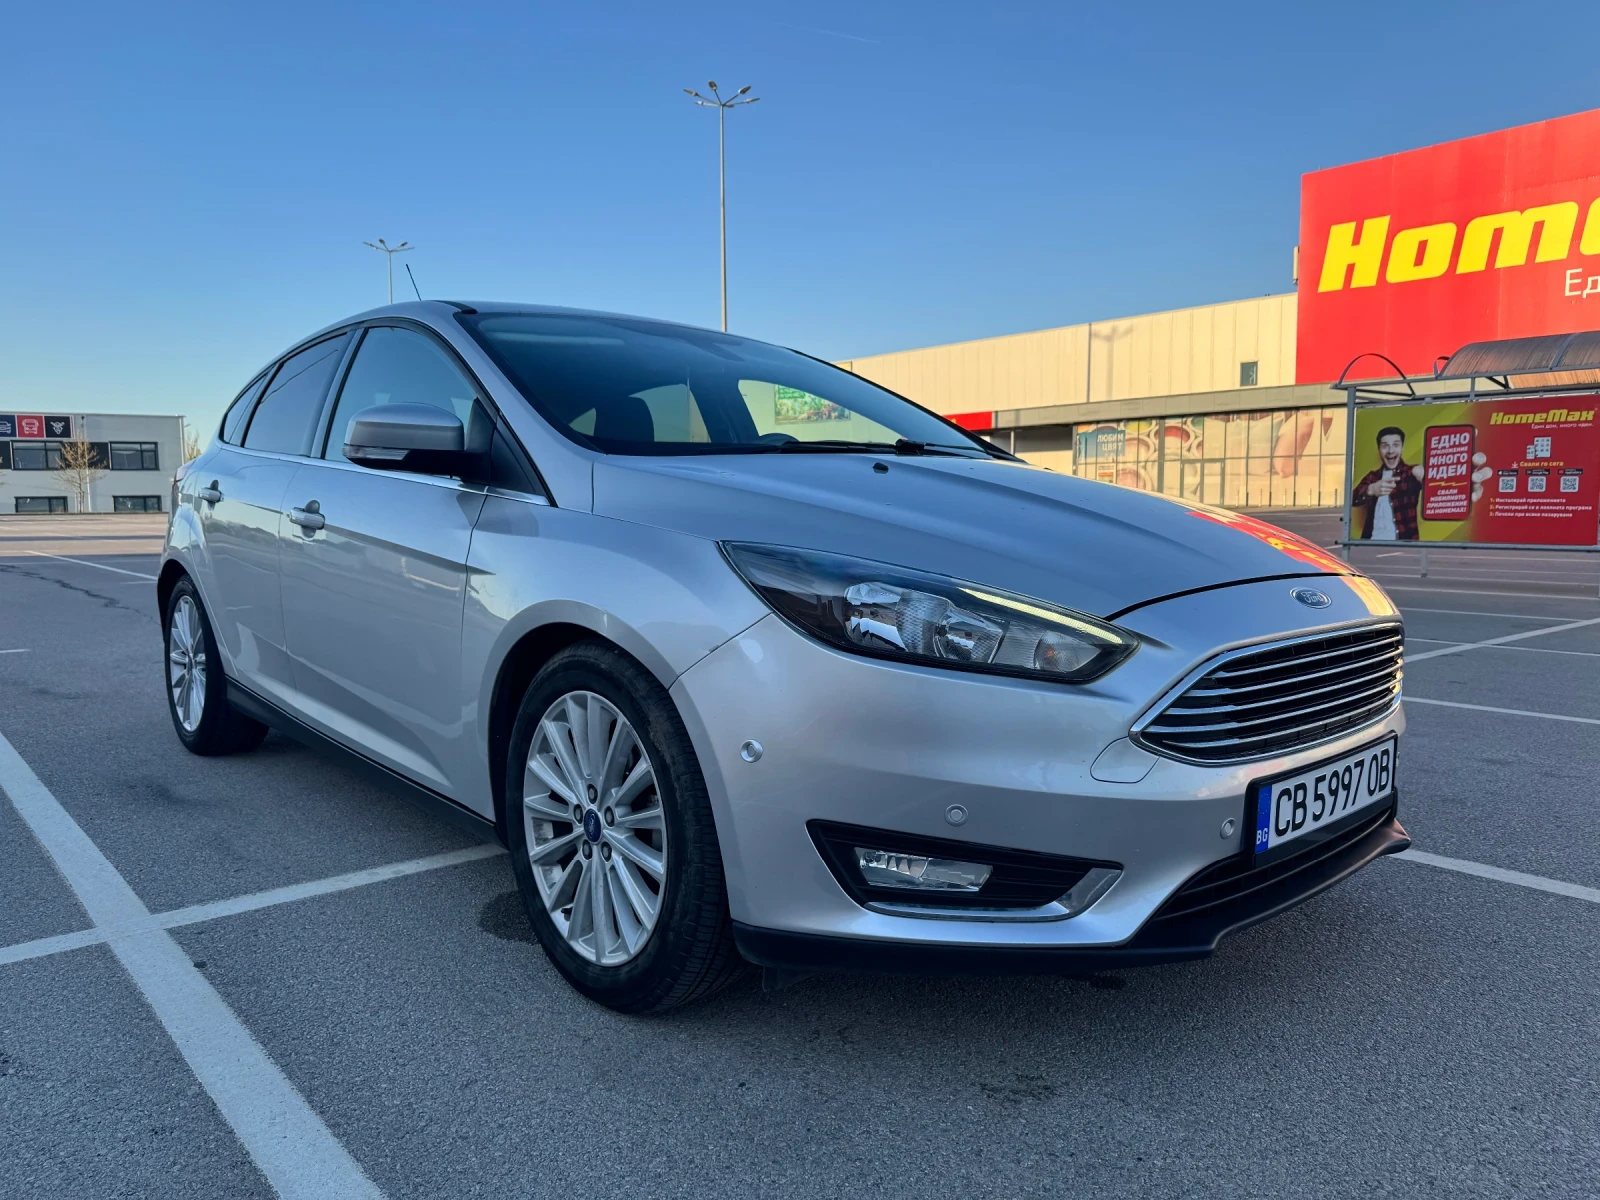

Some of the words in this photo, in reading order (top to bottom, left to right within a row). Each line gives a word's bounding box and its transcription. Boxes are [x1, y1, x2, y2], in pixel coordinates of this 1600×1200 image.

[1490, 409, 1595, 425] HomeMax
[1431, 433, 1470, 448] ЕДНО
[1430, 446, 1468, 455] ПРИЛОЖЕНИЕ
[1429, 453, 1468, 466] МНОГО
[1428, 464, 1467, 479] ИДЕИ
[1426, 501, 1467, 509] ПРИЛОЖЕНИЕ
[1300, 591, 1324, 604] Ford
[1275, 782, 1308, 837] CB
[1312, 757, 1365, 823] 5997
[1367, 748, 1390, 797] OB
[1256, 827, 1269, 845] BG
